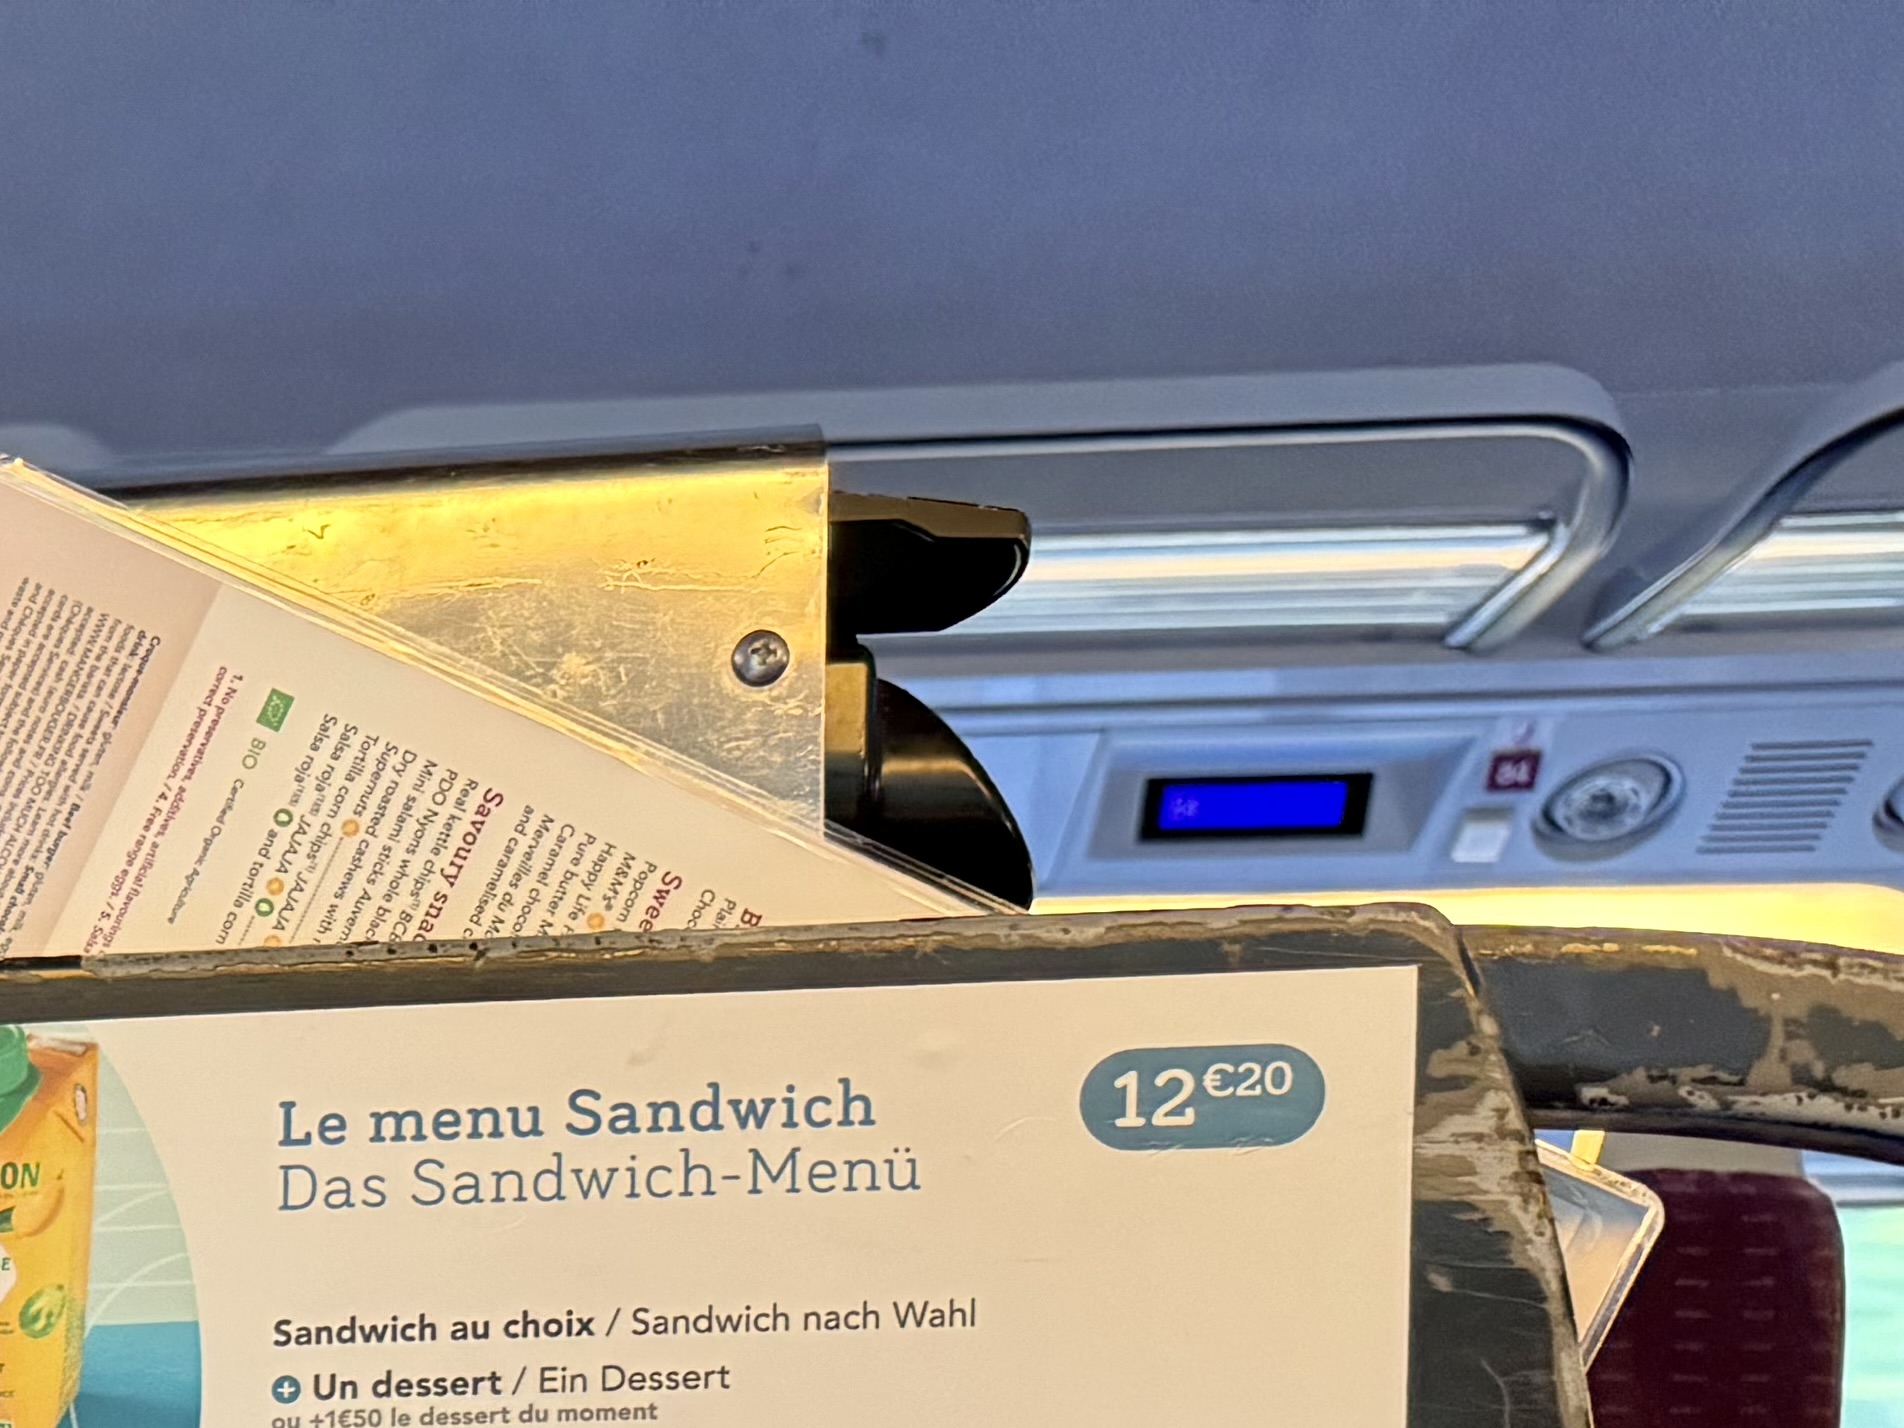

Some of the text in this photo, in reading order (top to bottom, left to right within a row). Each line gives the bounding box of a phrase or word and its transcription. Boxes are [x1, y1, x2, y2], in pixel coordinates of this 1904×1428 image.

[239, 735, 267, 772] BIO
[347, 739, 400, 819] Supernuts
[363, 758, 438, 888] Mini salami sticks
[434, 783, 505, 890] Savoury
[466, 803, 538, 928] and caramelised
[612, 858, 657, 925] Popcorn
[277, 1076, 877, 1148] Le menu Sandwich
[277, 1145, 922, 1212] Das Sandwich-Menü
[272, 1312, 438, 1348] Sandwich
[450, 1319, 490, 1342] au
[502, 1308, 596, 1340] choix
[631, 1301, 790, 1337] Sandwich
[803, 1299, 881, 1332] nach
[891, 1296, 977, 1329] Wahl
[312, 1372, 359, 1402] Un
[371, 1368, 503, 1399] dessert
[539, 1365, 588, 1394] Ein
[601, 1364, 731, 1393] Dessert
[390, 1406, 412, 1428] le
[418, 1405, 512, 1427] dessert
[517, 1402, 550, 1424] du
[556, 1401, 659, 1423] moment
